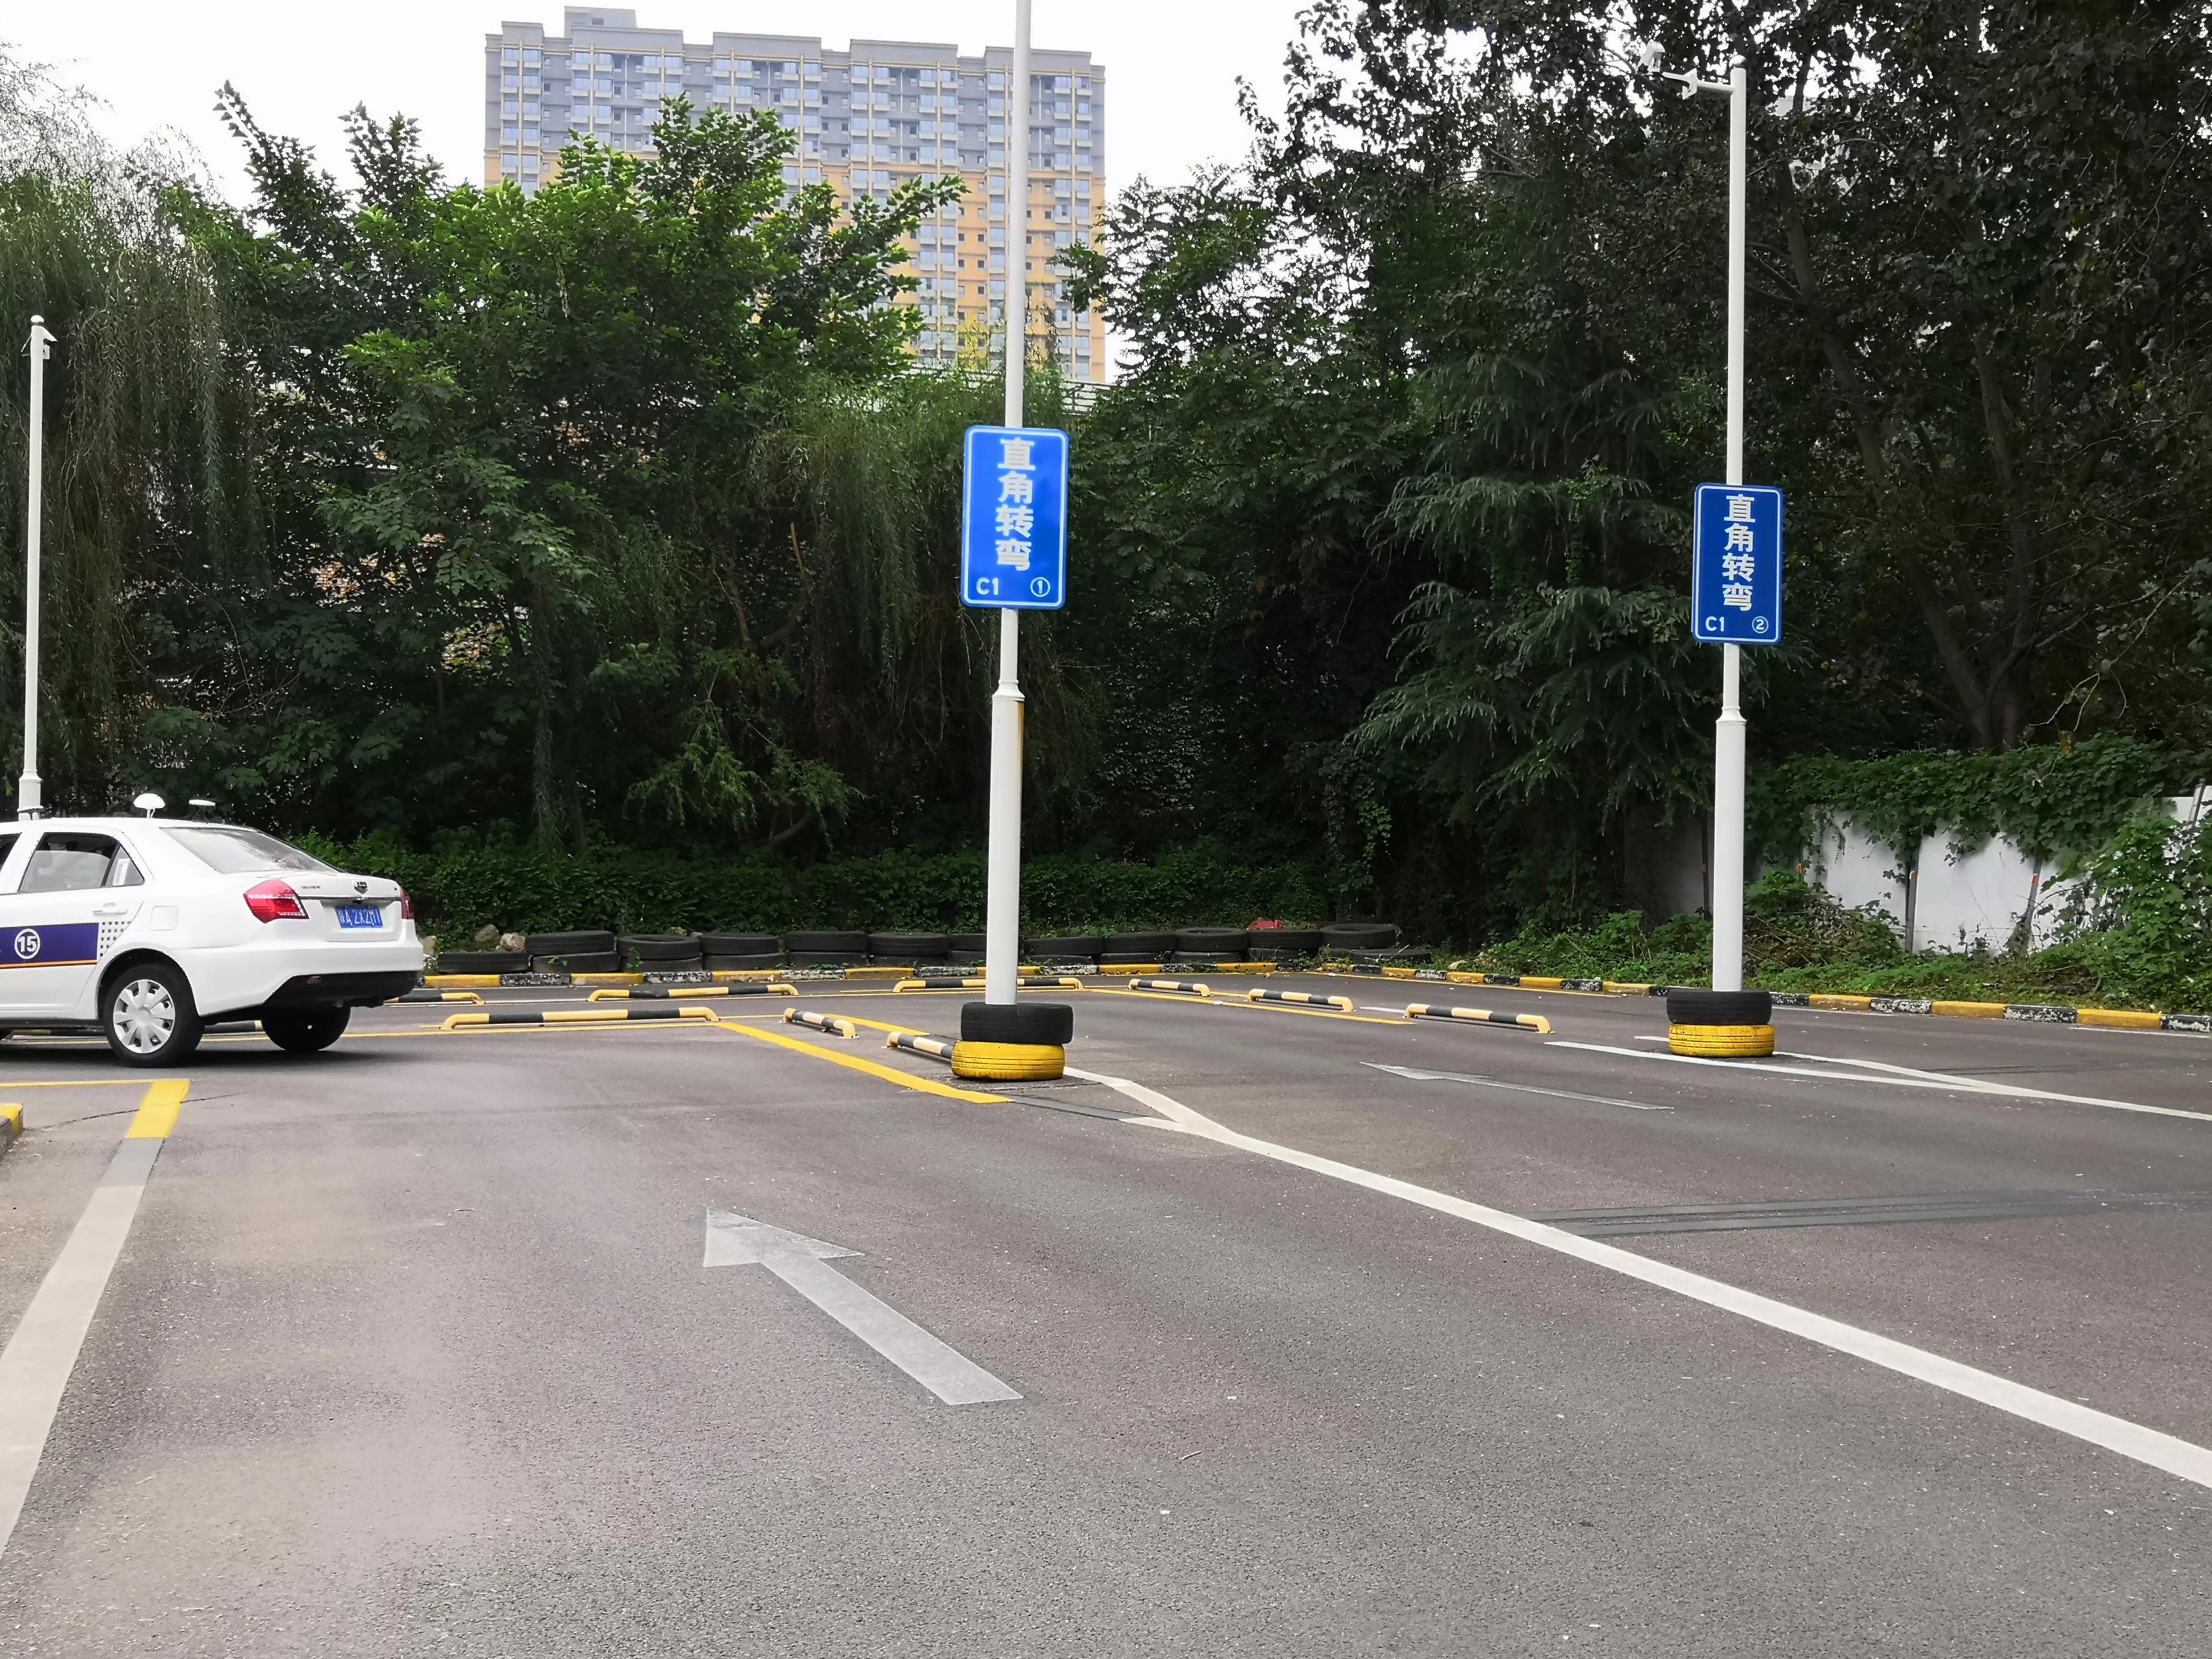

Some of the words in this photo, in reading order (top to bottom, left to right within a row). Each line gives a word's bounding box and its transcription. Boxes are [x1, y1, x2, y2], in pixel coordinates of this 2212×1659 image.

[995, 437, 1036, 571] 直角转弯
[976, 577, 999, 595] C1
[1722, 494, 1755, 611] 直角转弯
[1705, 616, 1725, 632] C1
